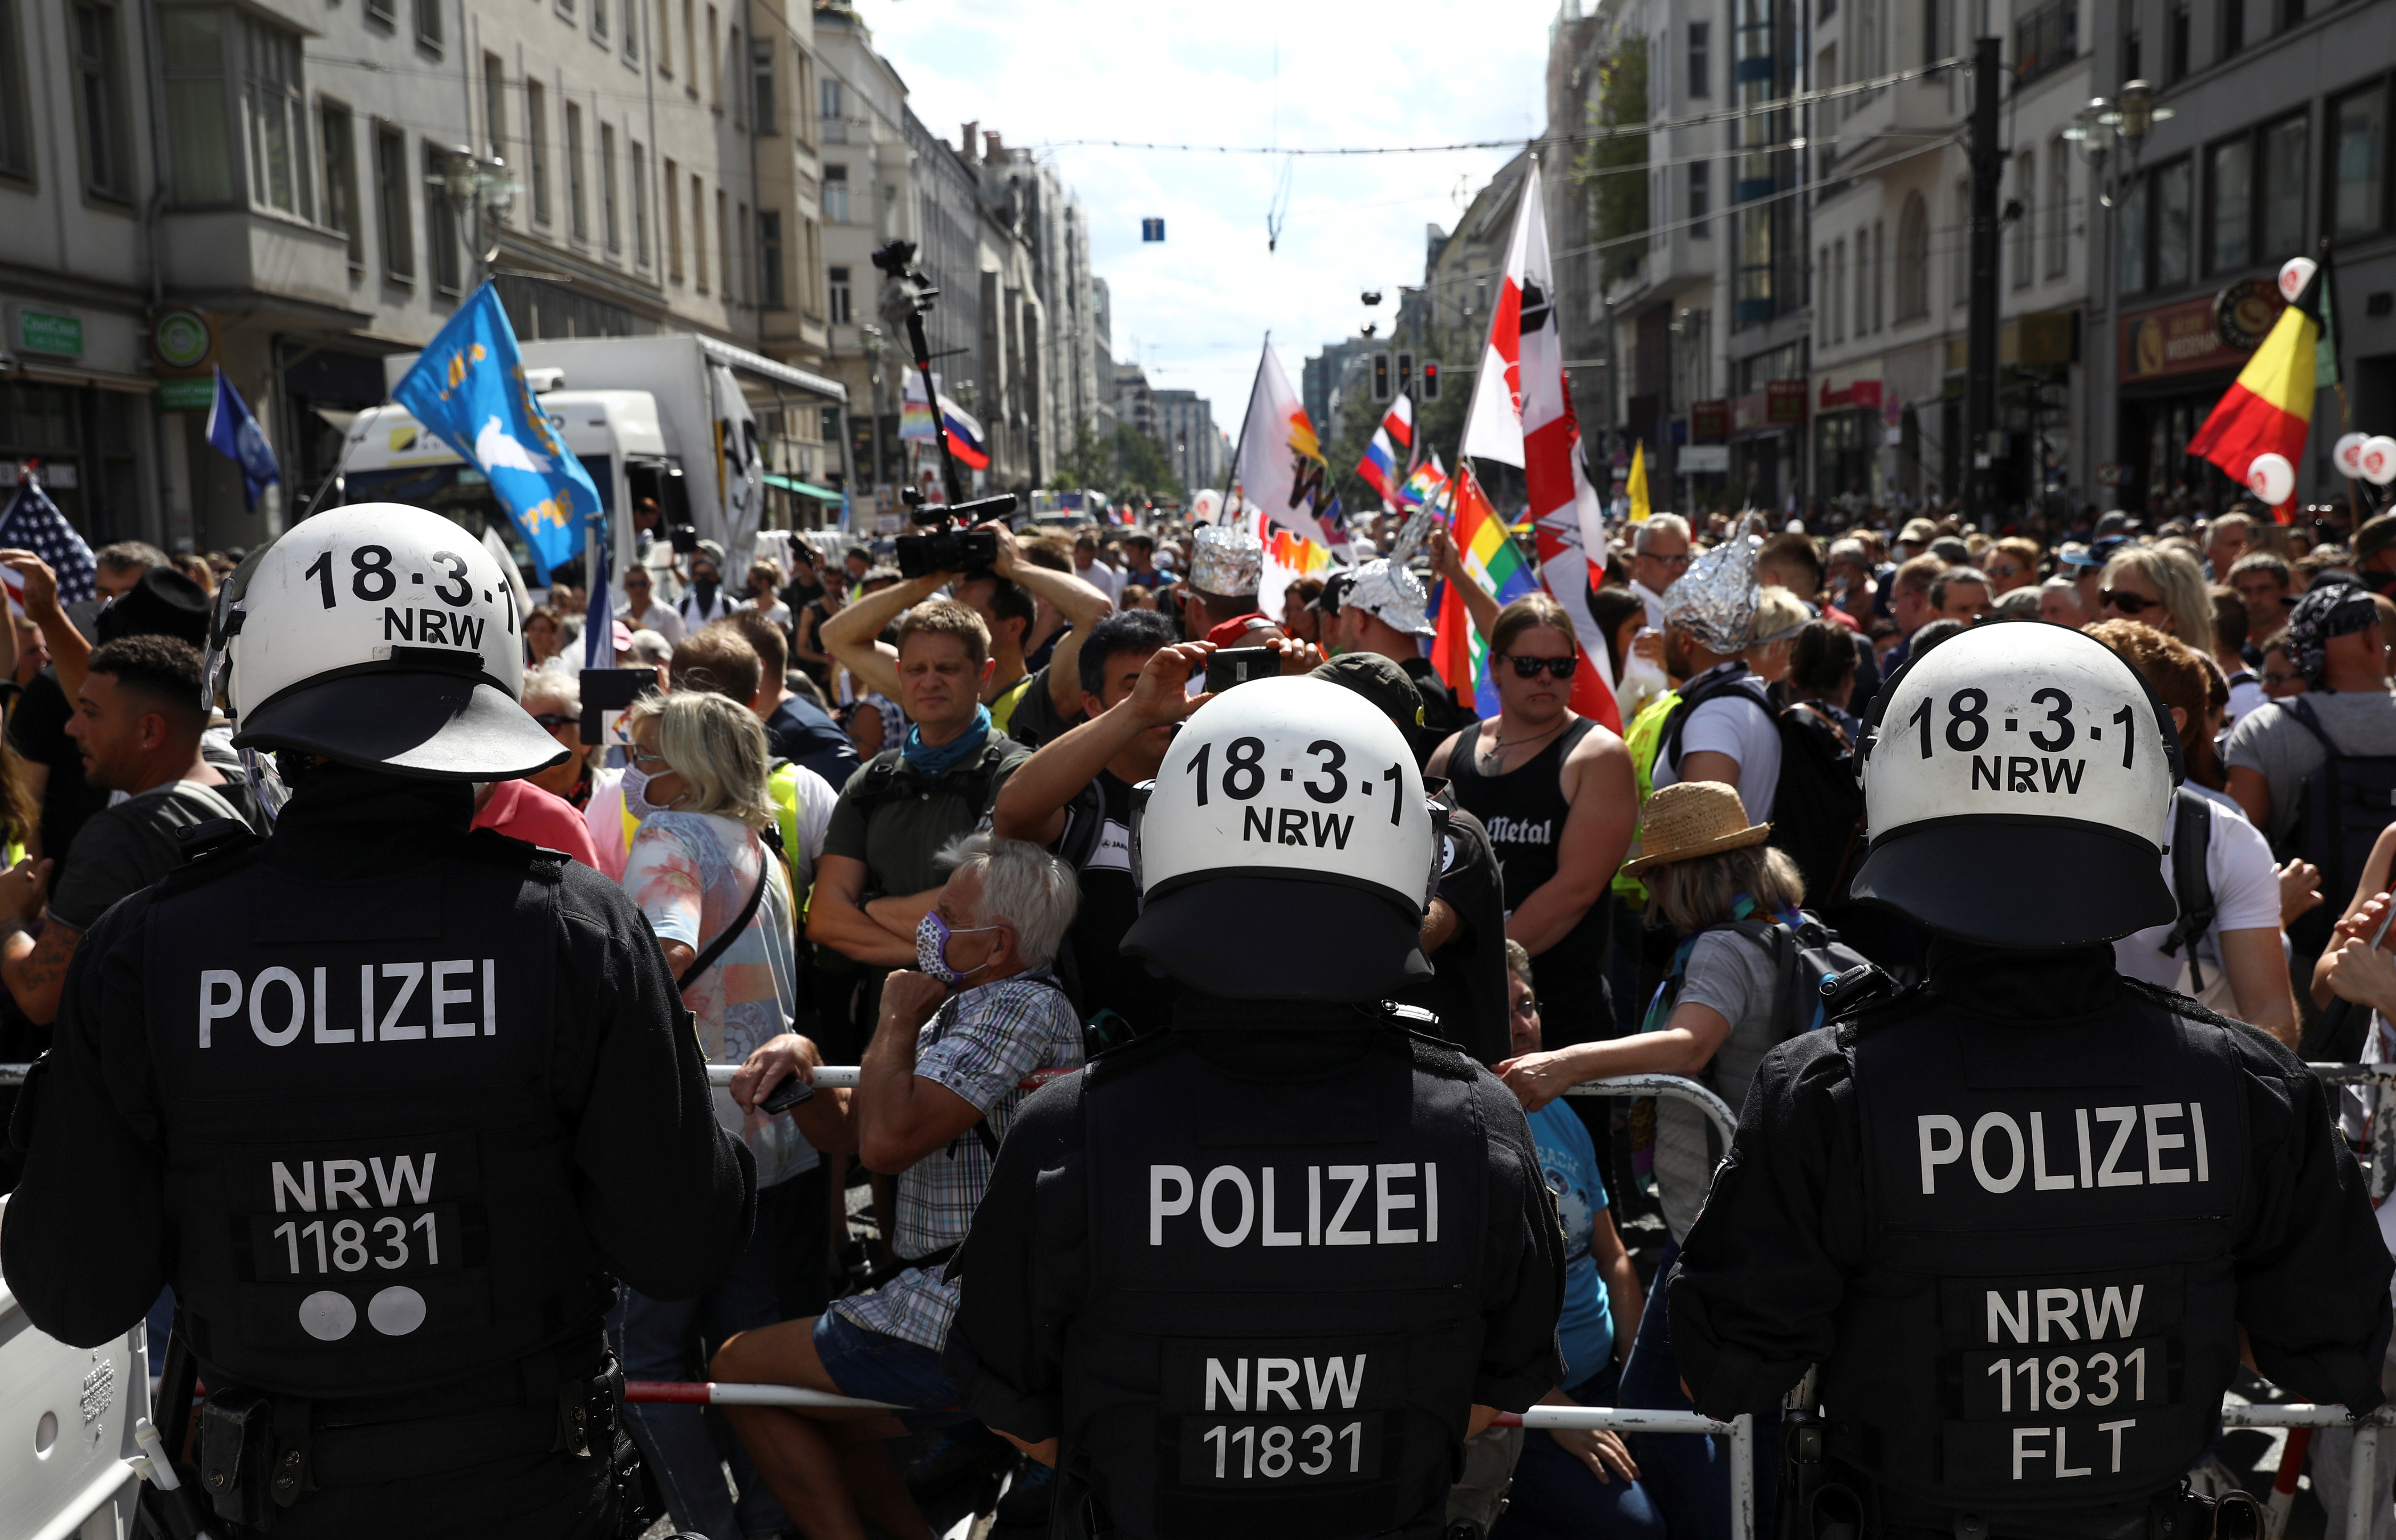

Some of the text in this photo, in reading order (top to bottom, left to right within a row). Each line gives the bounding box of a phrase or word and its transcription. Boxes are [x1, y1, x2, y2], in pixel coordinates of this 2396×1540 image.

[384, 607, 485, 650] NRW
[1972, 755, 2086, 794] NRW
[1244, 806, 1355, 850] NRW
[1487, 816, 1552, 844] Metal
[200, 959, 496, 1049] POLIZEI
[1536, 1146, 1579, 1176] EACH
[1918, 1103, 2209, 1194] POLIZEI
[272, 1153, 437, 1213] NRW
[1150, 1163, 1438, 1248] POLIZEI
[274, 1213, 438, 1274] 11831
[1987, 1285, 2145, 1343] NRW
[1205, 1354, 1367, 1411] NRW
[1988, 1348, 2145, 1412] 11831
[1204, 1422, 1362, 1478] 11831
[2013, 1419, 2136, 1480] FLT
